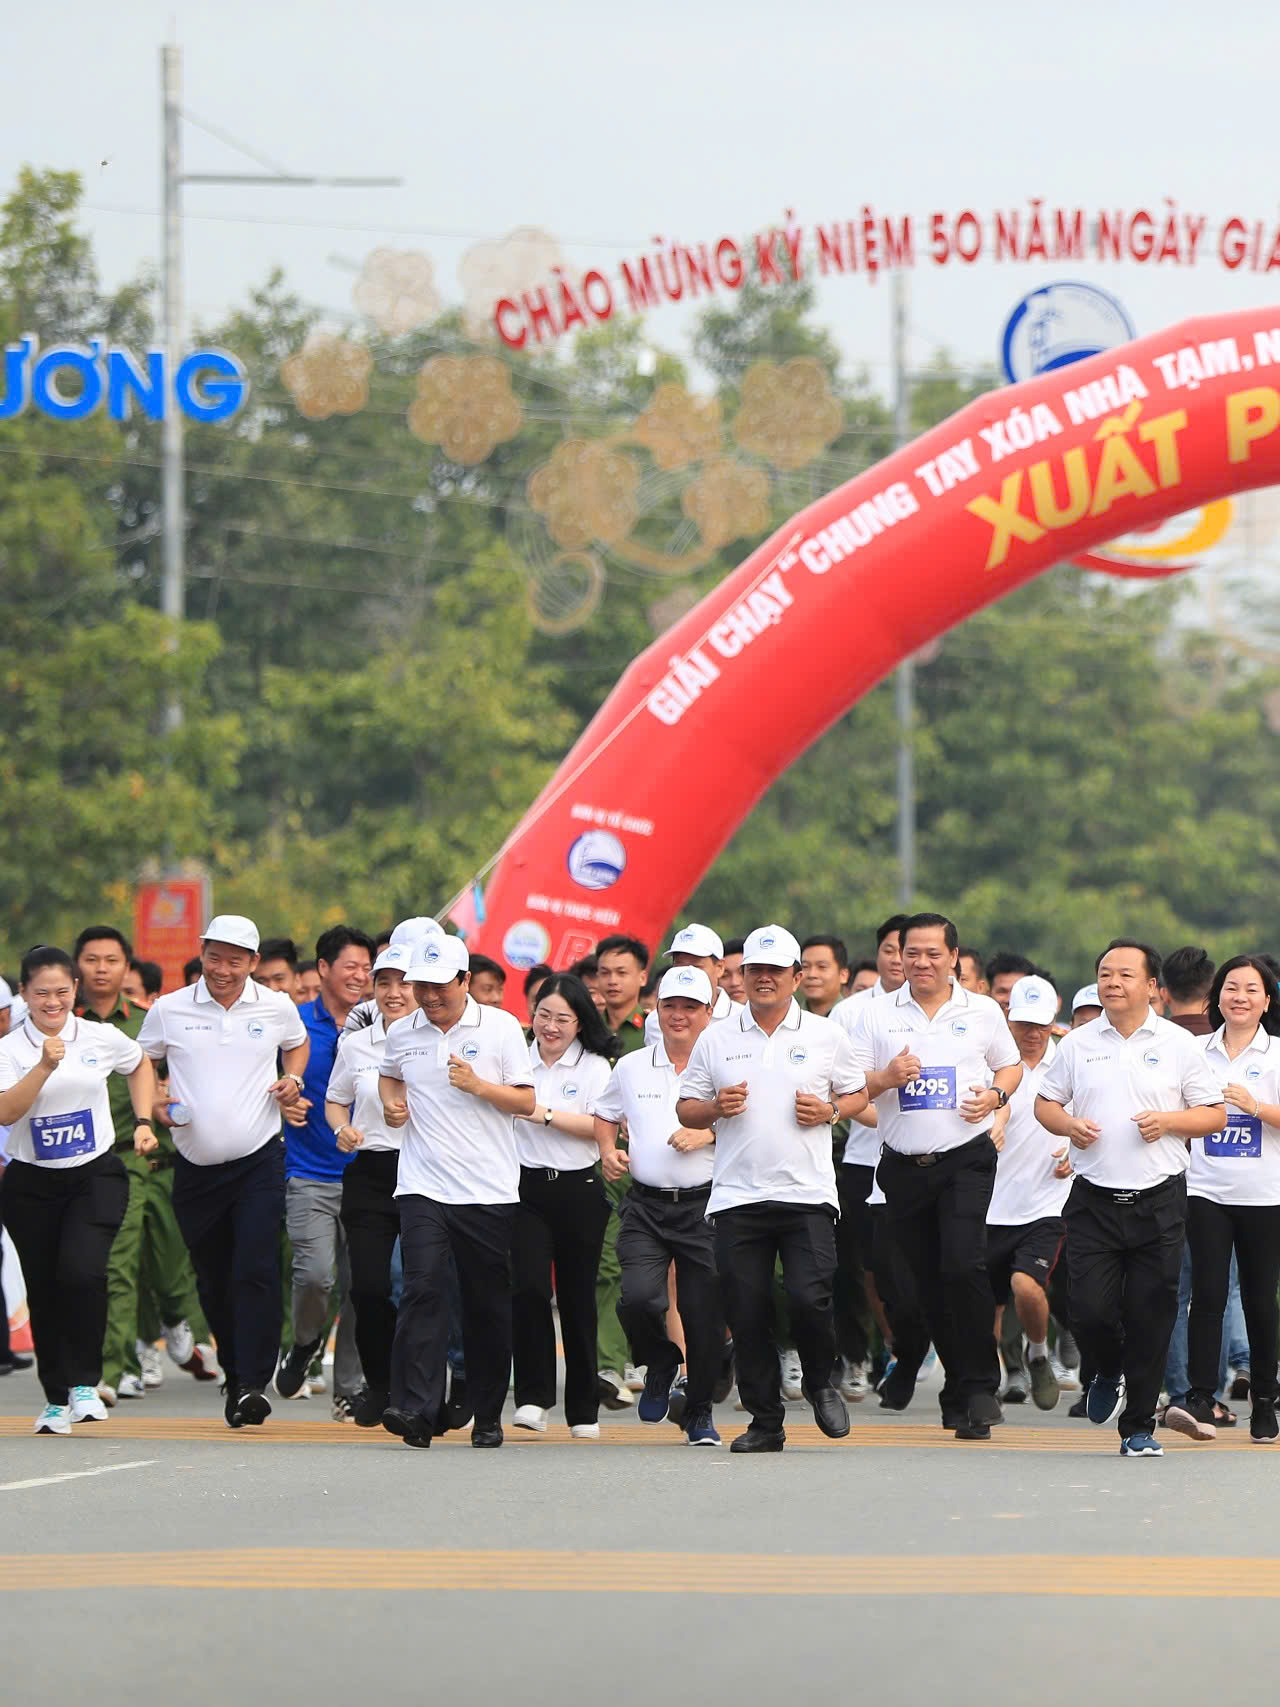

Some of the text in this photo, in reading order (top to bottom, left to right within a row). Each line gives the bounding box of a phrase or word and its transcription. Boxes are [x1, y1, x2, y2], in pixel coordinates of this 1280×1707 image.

[494, 265, 616, 351] CHÀO
[619, 235, 745, 312] MỪNG
[815, 205, 915, 286] NIỆM
[929, 210, 983, 266] 50
[994, 196, 1086, 264] NĂM
[1096, 195, 1206, 264] NGÀY
[965, 398, 1188, 571] XUẤT
[646, 652, 721, 726] GIẢI
[707, 570, 795, 659] CHẠY
[914, 438, 982, 498] TAY
[977, 403, 1064, 463] XÓA
[1062, 363, 1150, 427] NHÀ
[904, 1078, 949, 1097] 4295
[41, 1123, 86, 1147] 5774
[1211, 1126, 1252, 1144] 5775
